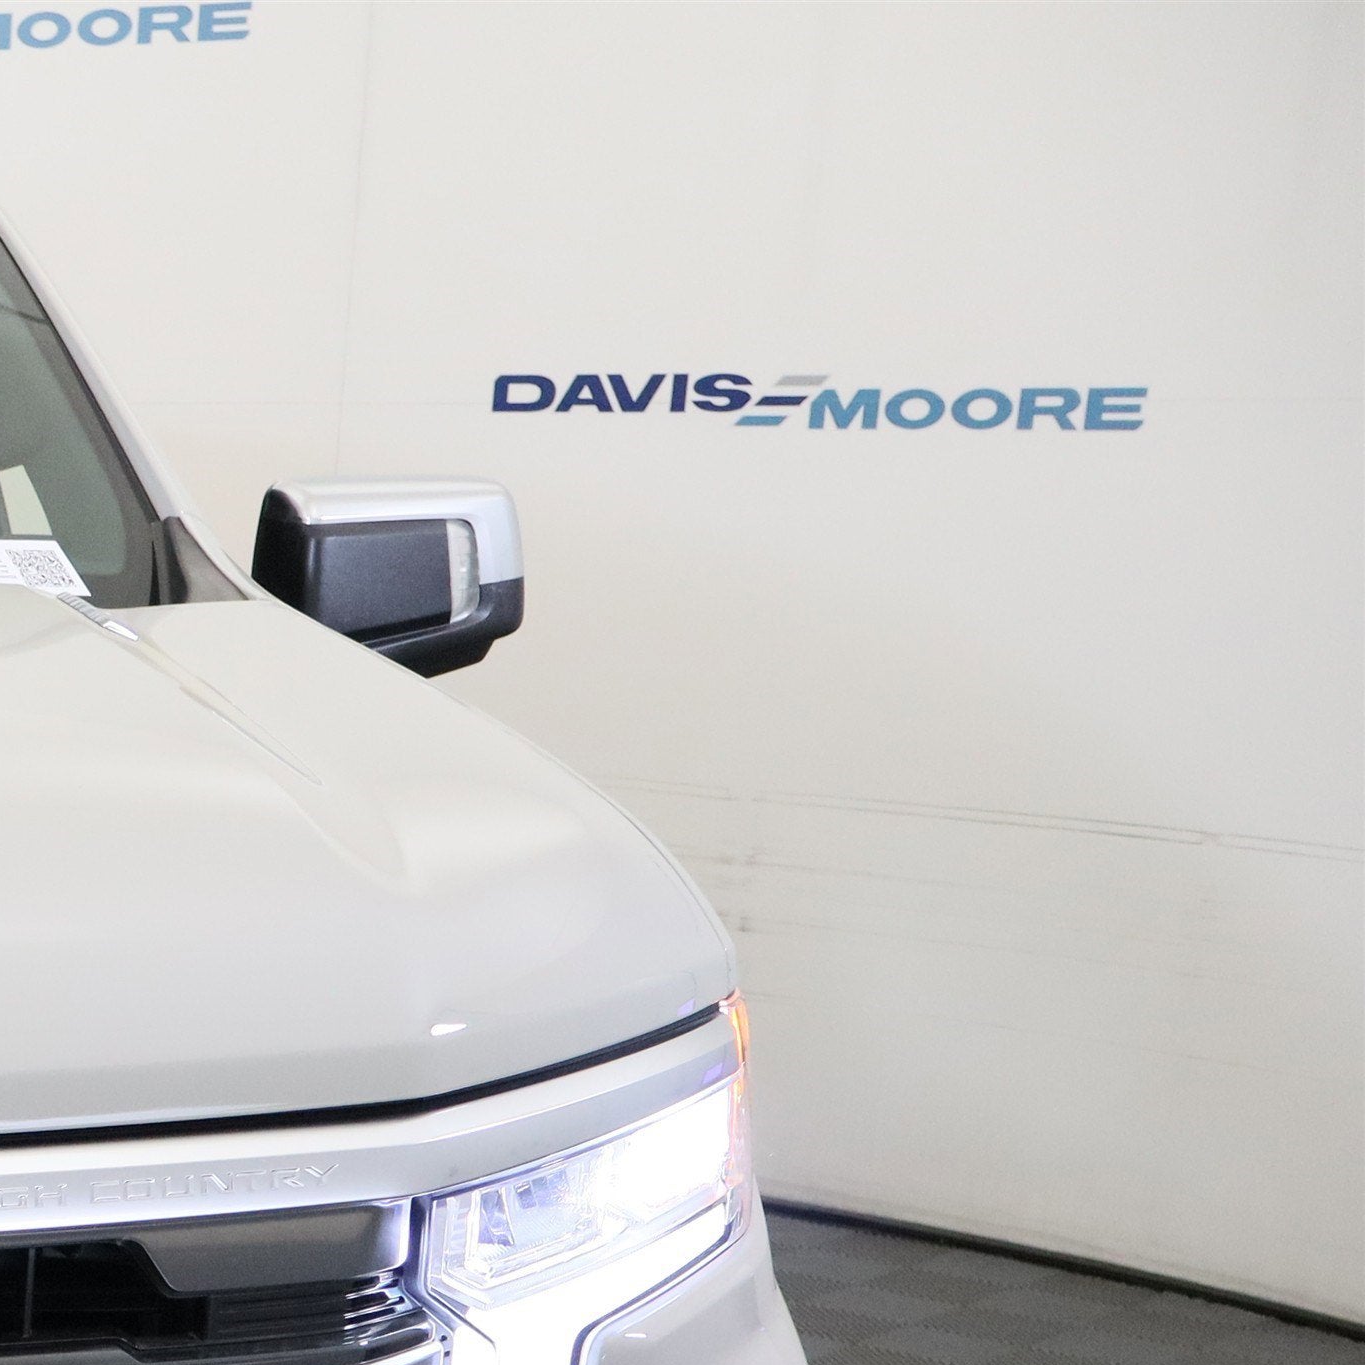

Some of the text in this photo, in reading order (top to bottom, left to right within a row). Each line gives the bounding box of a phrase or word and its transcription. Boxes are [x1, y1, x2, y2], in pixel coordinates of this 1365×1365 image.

[492, 373, 1148, 431] DAVIS MOORE
[89, 1163, 340, 1204] COUNTRY
